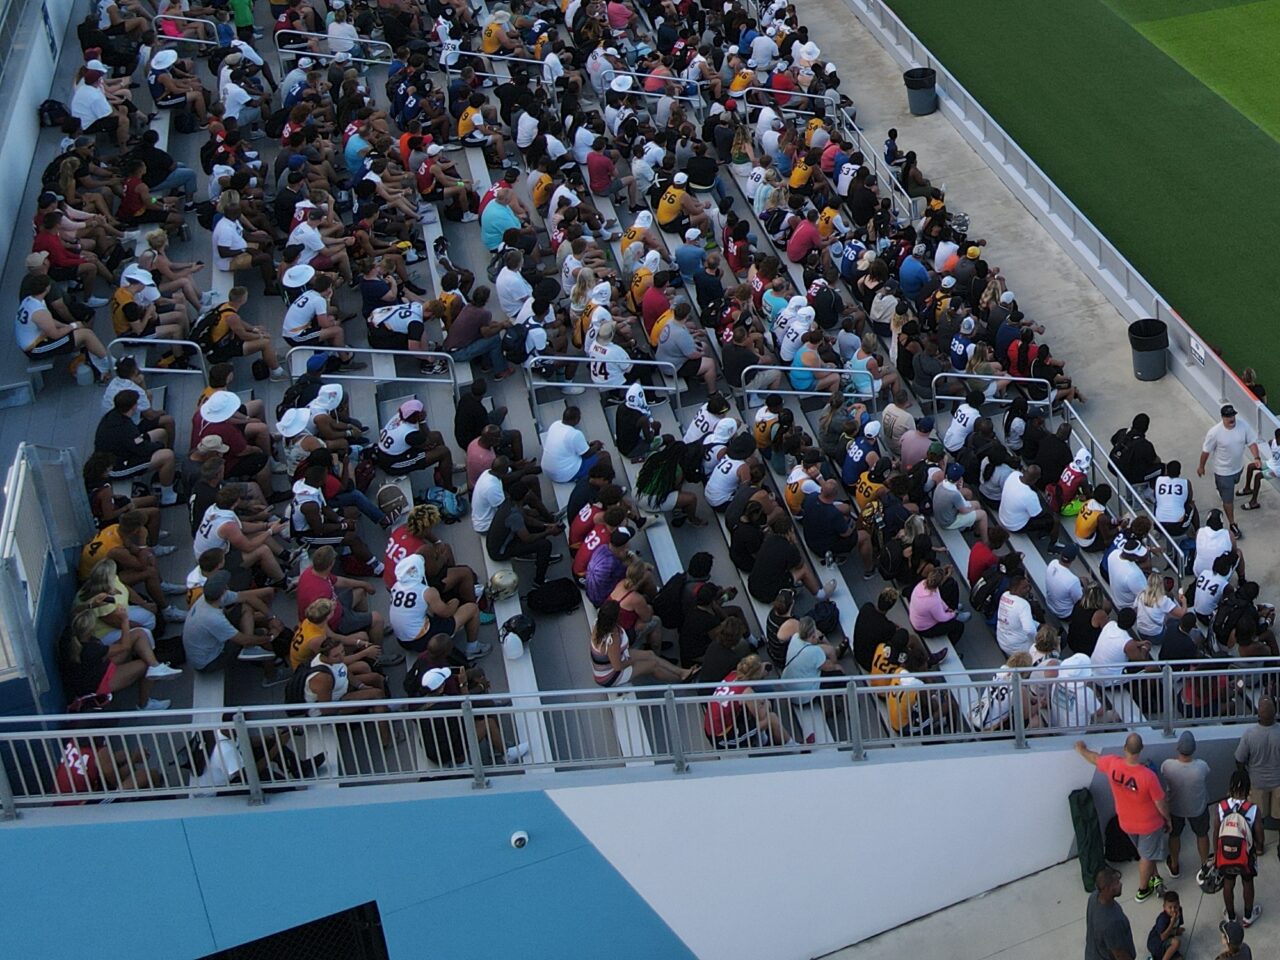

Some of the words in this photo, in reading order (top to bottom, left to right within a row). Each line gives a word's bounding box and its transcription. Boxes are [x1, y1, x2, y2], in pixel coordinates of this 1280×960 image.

[662, 191, 677, 204] 56
[1158, 483, 1183, 496] 613
[1196, 575, 1220, 597] 214
[391, 589, 417, 609] 88
